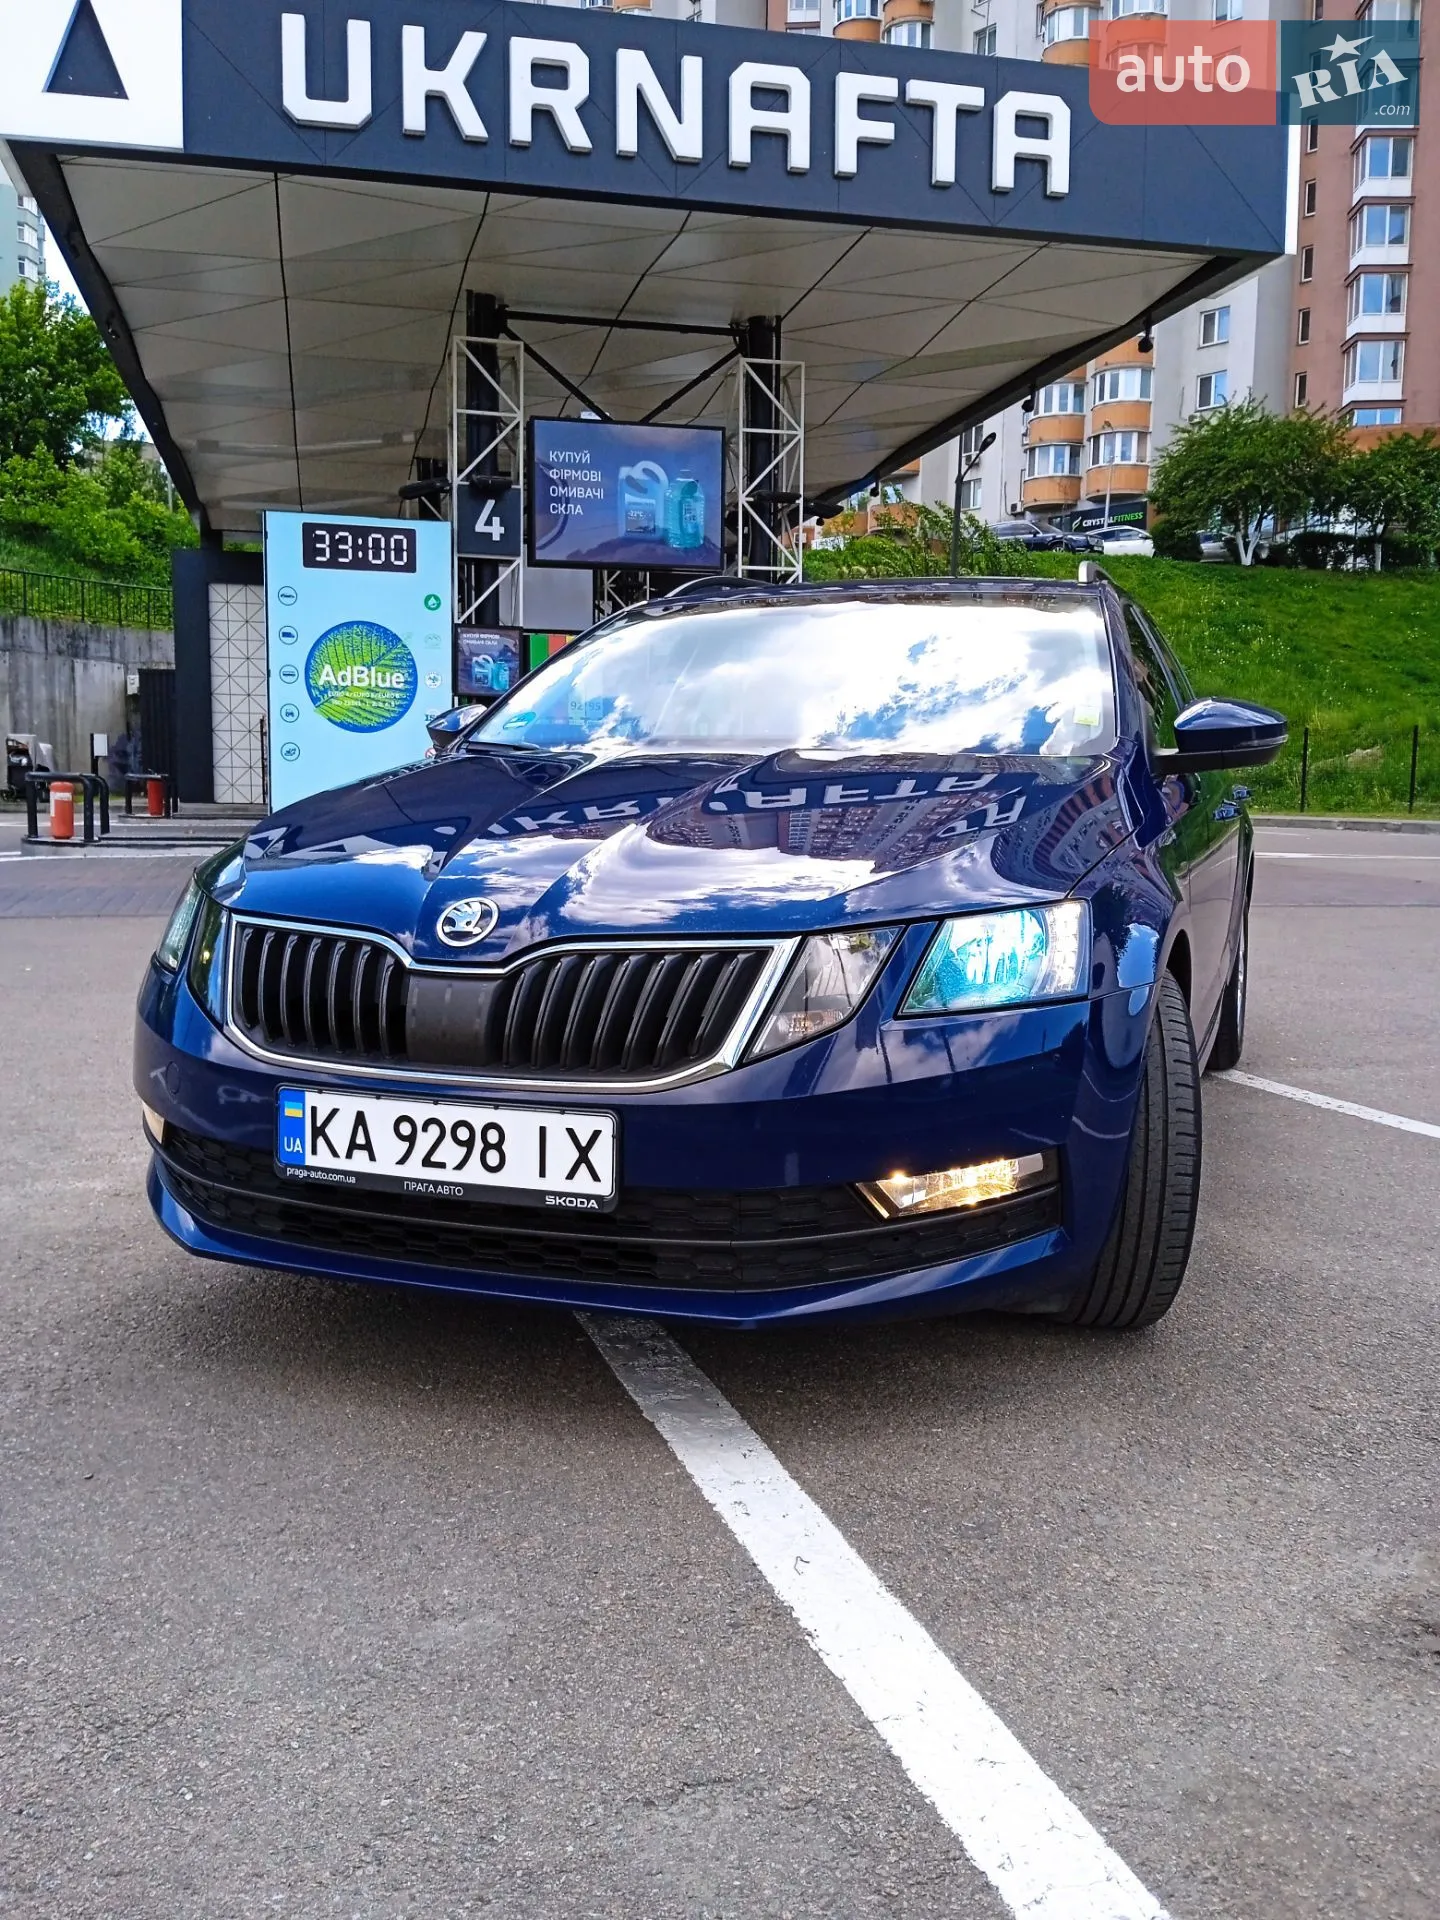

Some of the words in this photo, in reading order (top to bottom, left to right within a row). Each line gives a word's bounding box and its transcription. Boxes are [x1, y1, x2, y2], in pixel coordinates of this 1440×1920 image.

[281, 12, 1072, 198] UKRNAFTA
[549, 450, 591, 464] КУПУЙ
[549, 468, 602, 482] ФІРМОВІ
[549, 485, 604, 500] ОМИВАЧІ
[549, 503, 584, 516] СКЛА
[475, 499, 505, 541] 4
[313, 529, 408, 566] 33:00
[319, 664, 405, 689] AdBlue
[284, 1136, 303, 1154] UA
[310, 1106, 377, 1162] KA
[393, 1114, 506, 1174] 9298
[539, 1125, 603, 1183] IX
[286, 1167, 357, 1184] praga-auto.com.ua
[403, 1180, 435, 1193] ПРАГА
[436, 1182, 464, 1196] АВТО
